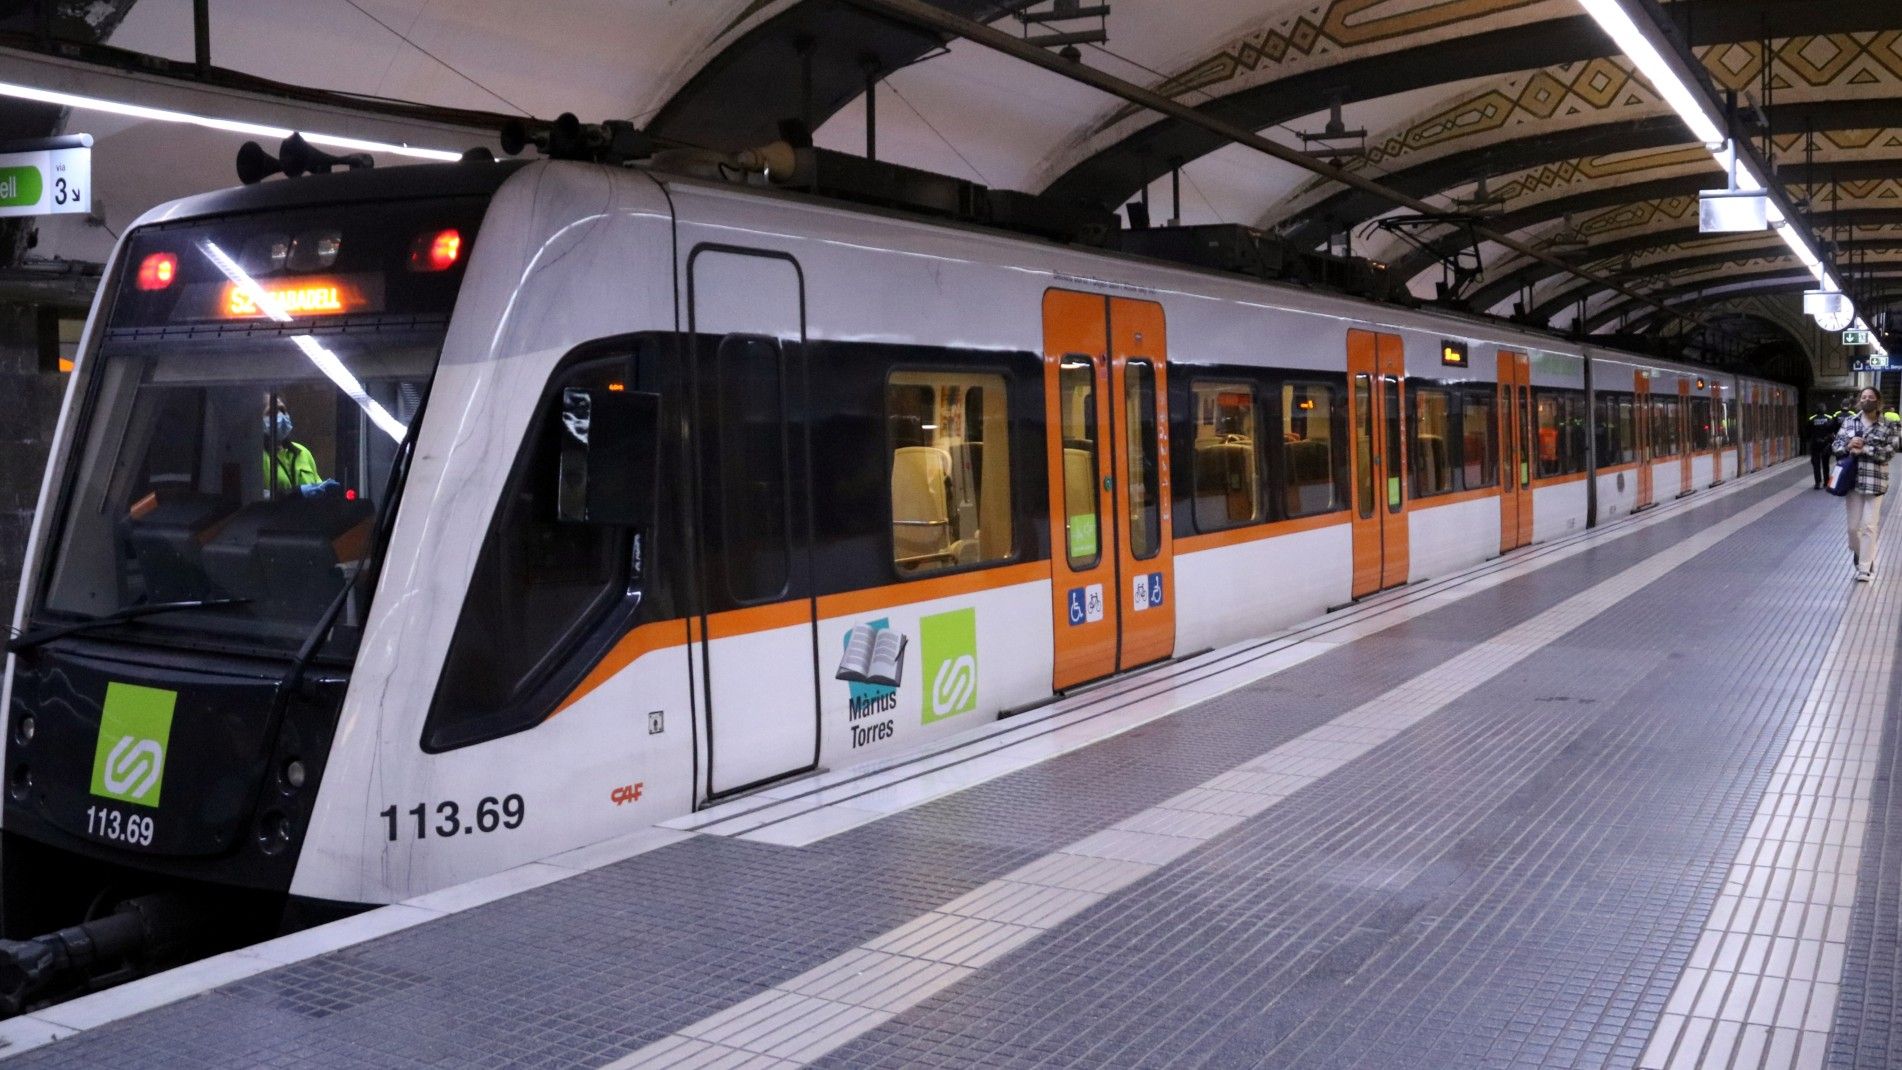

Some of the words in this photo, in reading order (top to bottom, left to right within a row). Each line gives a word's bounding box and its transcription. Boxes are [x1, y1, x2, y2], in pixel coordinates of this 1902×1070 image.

[56, 163, 66, 172] via
[55, 177, 68, 205] 3
[264, 287, 342, 312] ABADELL
[849, 689, 897, 722] Màrius
[851, 719, 894, 749] Torres
[610, 782, 643, 806] CAF
[87, 805, 154, 846] 113.69
[380, 793, 525, 841] 113.69
